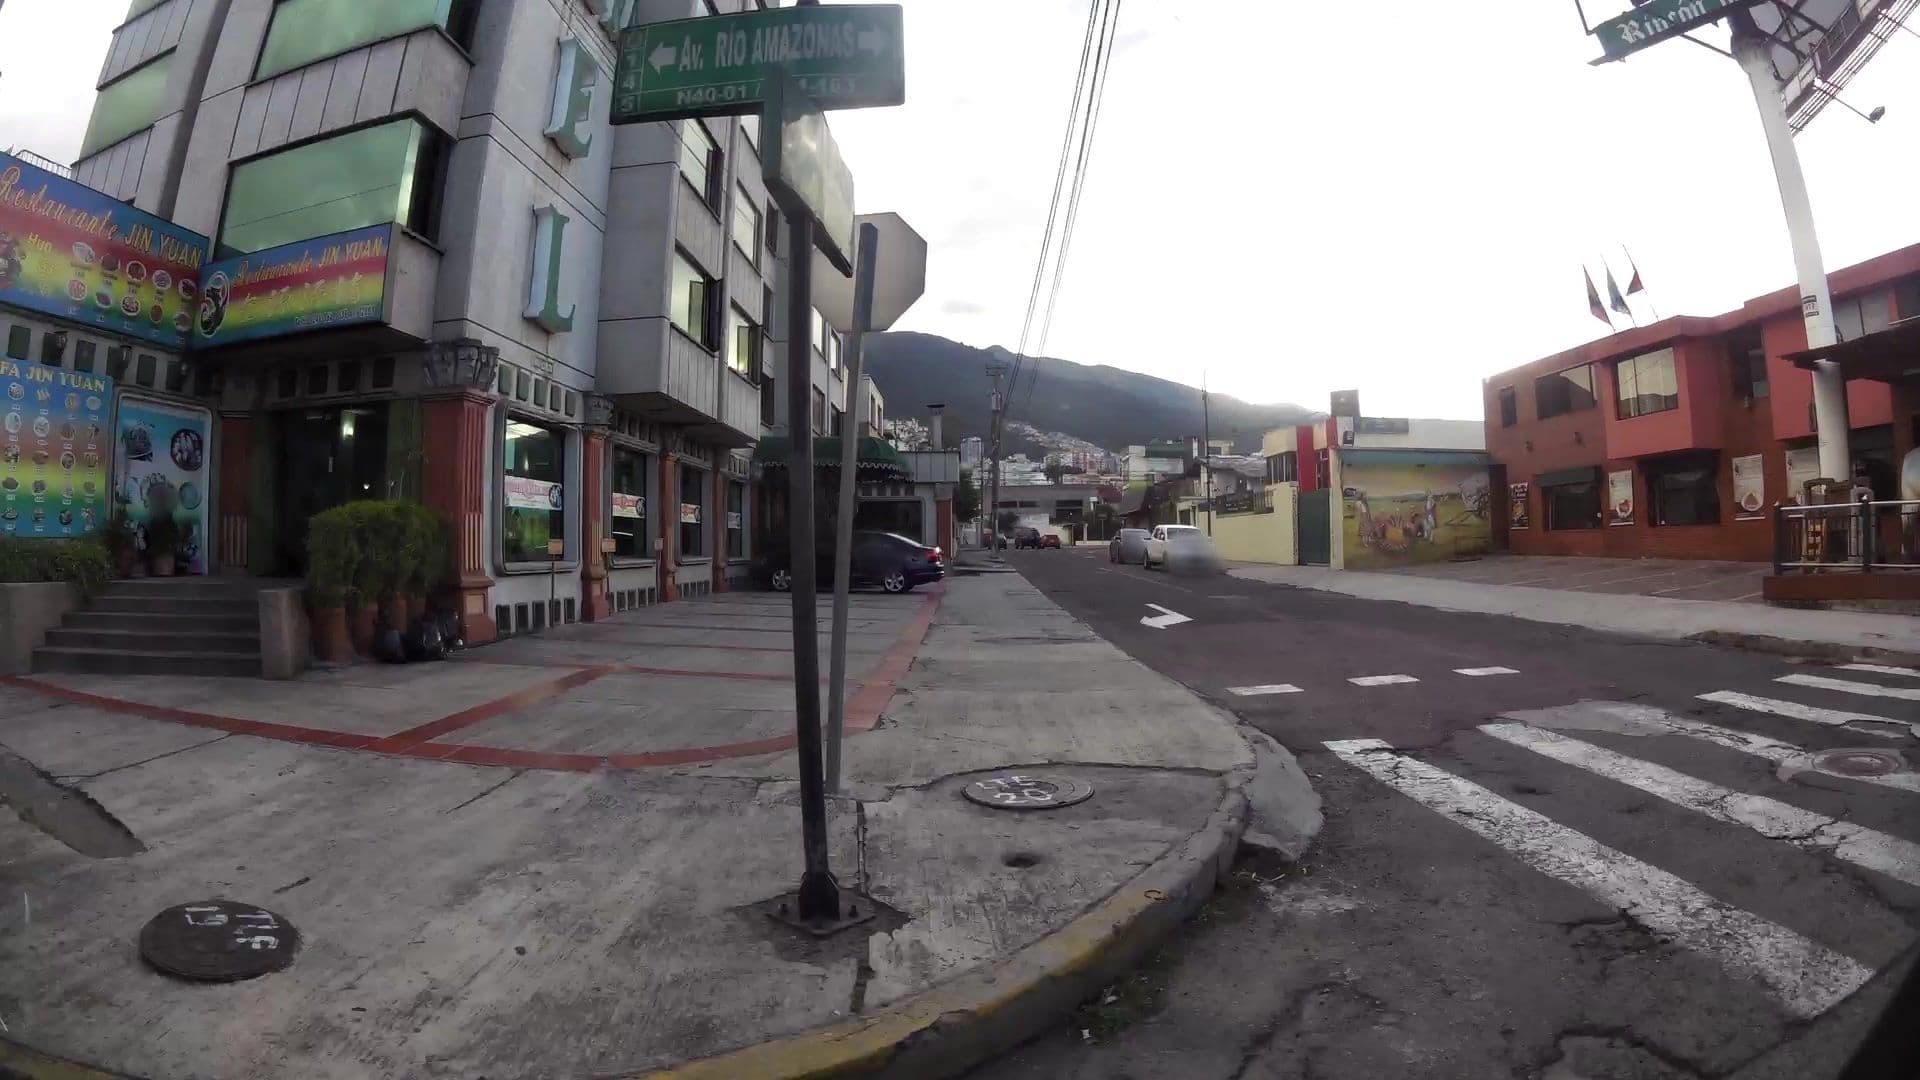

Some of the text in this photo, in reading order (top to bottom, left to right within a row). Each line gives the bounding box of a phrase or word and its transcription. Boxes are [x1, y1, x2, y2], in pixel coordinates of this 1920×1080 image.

[679, 21, 857, 72] Av. RÍO AMAZONAS
[0, 166, 203, 270] Restaurante JIN YUAN
[319, 245, 341, 268] JIN
[344, 236, 384, 263] YUAN
[26, 366, 54, 383] JIN
[60, 371, 106, 393] YUAN
